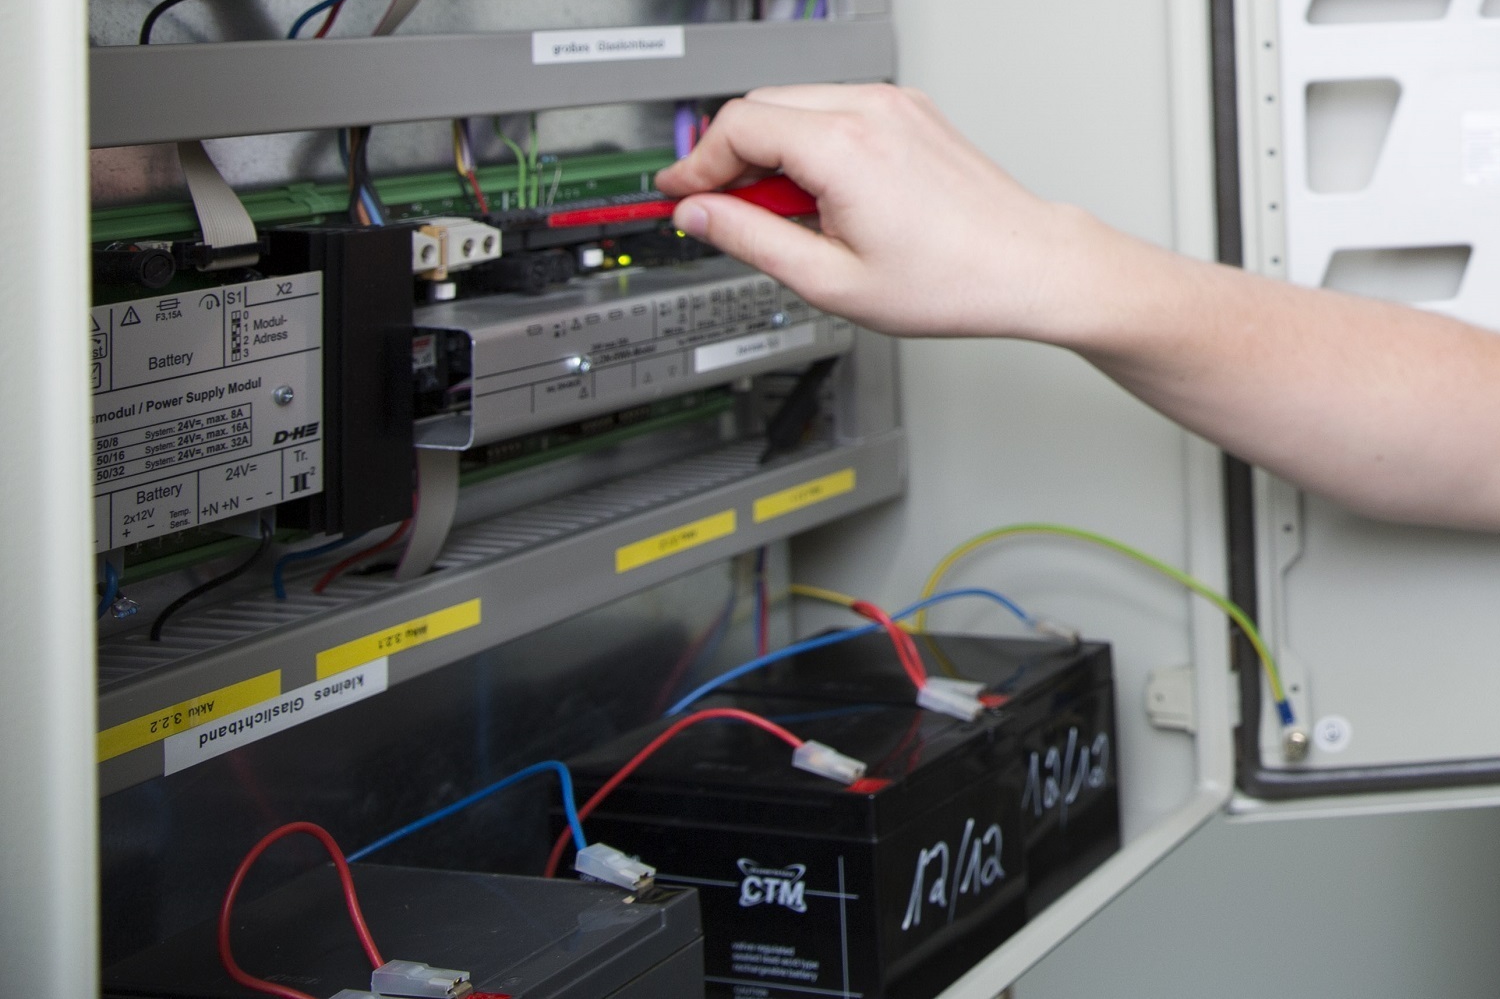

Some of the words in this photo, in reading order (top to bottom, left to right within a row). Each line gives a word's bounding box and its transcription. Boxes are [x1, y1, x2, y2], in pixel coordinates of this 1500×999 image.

[226, 290, 242, 305] S1
[276, 281, 293, 296] X2
[243, 310, 249, 320] 0
[253, 314, 288, 331] Modul-
[243, 323, 249, 333] 1
[243, 335, 249, 345] 2
[253, 330, 288, 346] Adress
[148, 352, 194, 371] Battery
[243, 348, 249, 358] 3
[146, 395, 184, 413] Power
[186, 386, 226, 403] Supply
[228, 376, 262, 395] Modul
[96, 437, 119, 451] 50/8
[144, 425, 176, 440] System:
[206, 414, 229, 425] max.
[230, 408, 244, 419] 8A
[96, 450, 126, 466] 50/16
[144, 441, 176, 455] System:
[206, 429, 229, 440] max.
[231, 421, 249, 434] 16A
[96, 465, 125, 481] 50/32
[144, 455, 176, 470] System:
[206, 443, 229, 455] max.
[231, 435, 249, 448] 32A
[293, 449, 309, 463] Tr.
[225, 462, 258, 482] 24V=
[136, 483, 183, 506] Battery
[169, 507, 192, 520] Temp.
[200, 502, 219, 517] +N
[221, 496, 240, 511] +N
[123, 508, 155, 526] 2x12V
[169, 518, 191, 530] Sens.
[313, 673, 365, 701] kleines
[187, 700, 216, 719] Akku
[149, 712, 183, 734] 3.2.2
[199, 697, 305, 749] Glaslichtband
[740, 875, 806, 907] CTM
